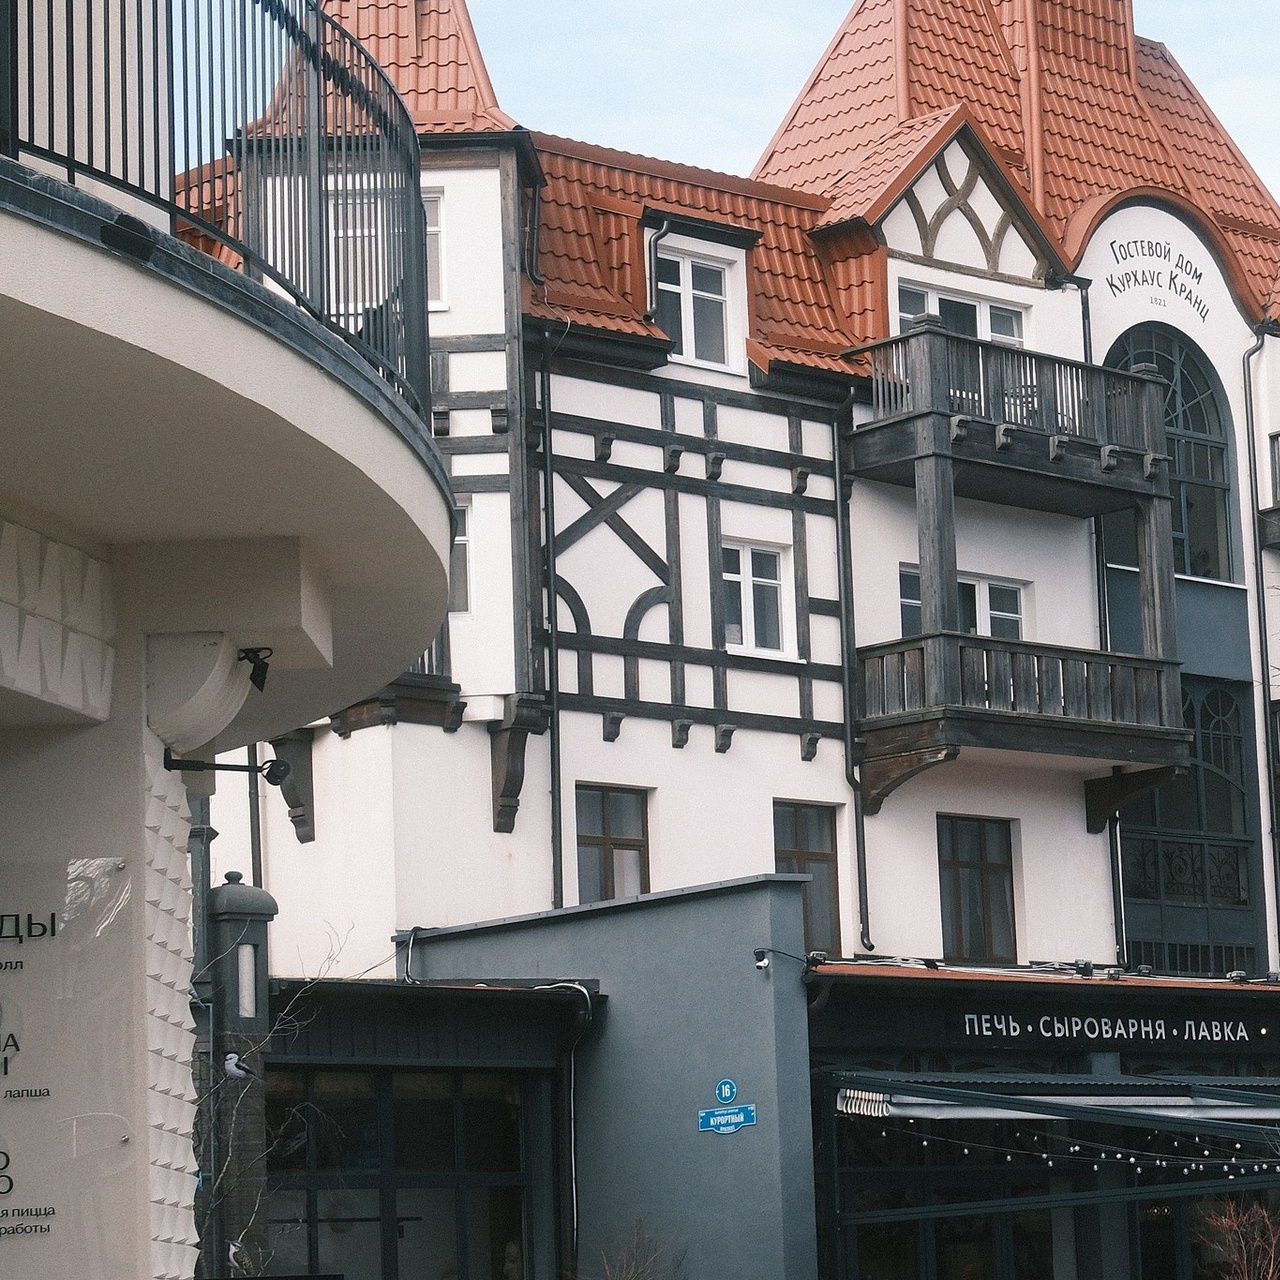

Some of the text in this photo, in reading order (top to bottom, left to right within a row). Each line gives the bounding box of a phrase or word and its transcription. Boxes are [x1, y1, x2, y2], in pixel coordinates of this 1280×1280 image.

[1150, 296, 1166, 307] 1821
[964, 1014, 1250, 1041] ПЕЧЬ СЫРОВАРНЯ ЛАВКА
[4, 1087, 50, 1098] лапша
[722, 1084, 731, 1098] 16
[12, 1206, 55, 1218] пицца
[0, 1223, 50, 1237] работы
